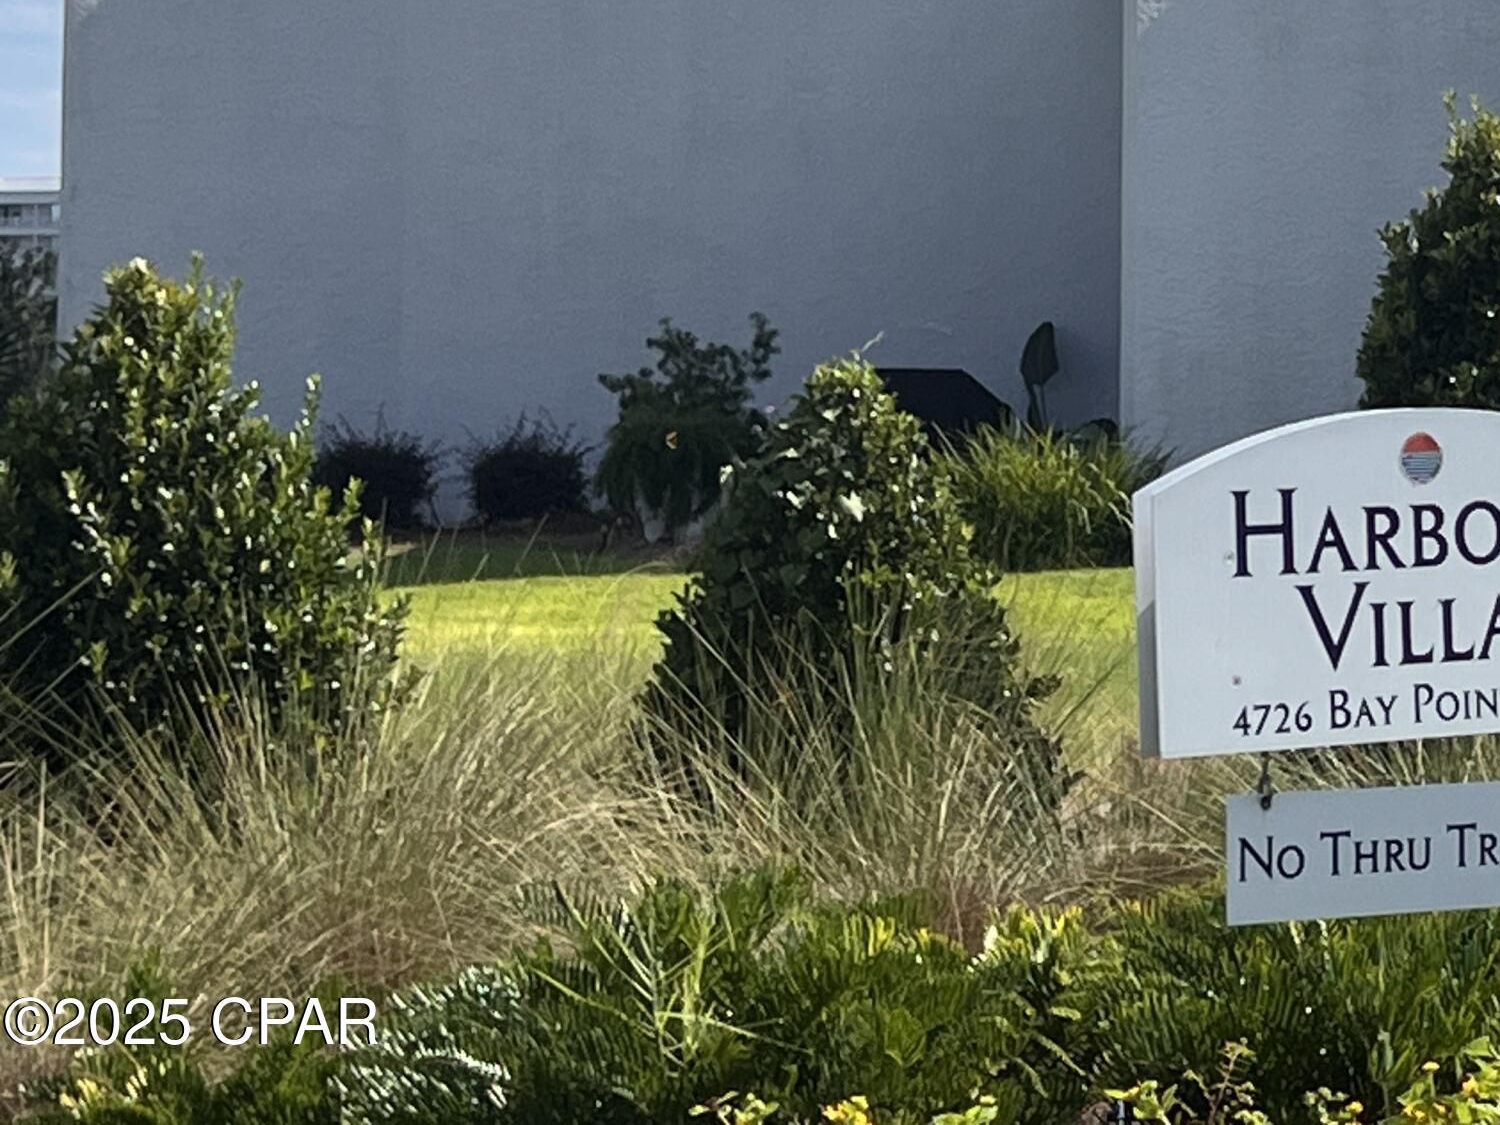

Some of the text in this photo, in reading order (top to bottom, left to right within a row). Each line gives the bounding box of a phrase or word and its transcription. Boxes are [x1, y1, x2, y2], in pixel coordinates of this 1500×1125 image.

[1233, 702, 1312, 737] 4726
[1328, 689, 1399, 730] BAY
[1238, 836, 1305, 883] NO
[1320, 830, 1431, 876] THRU
